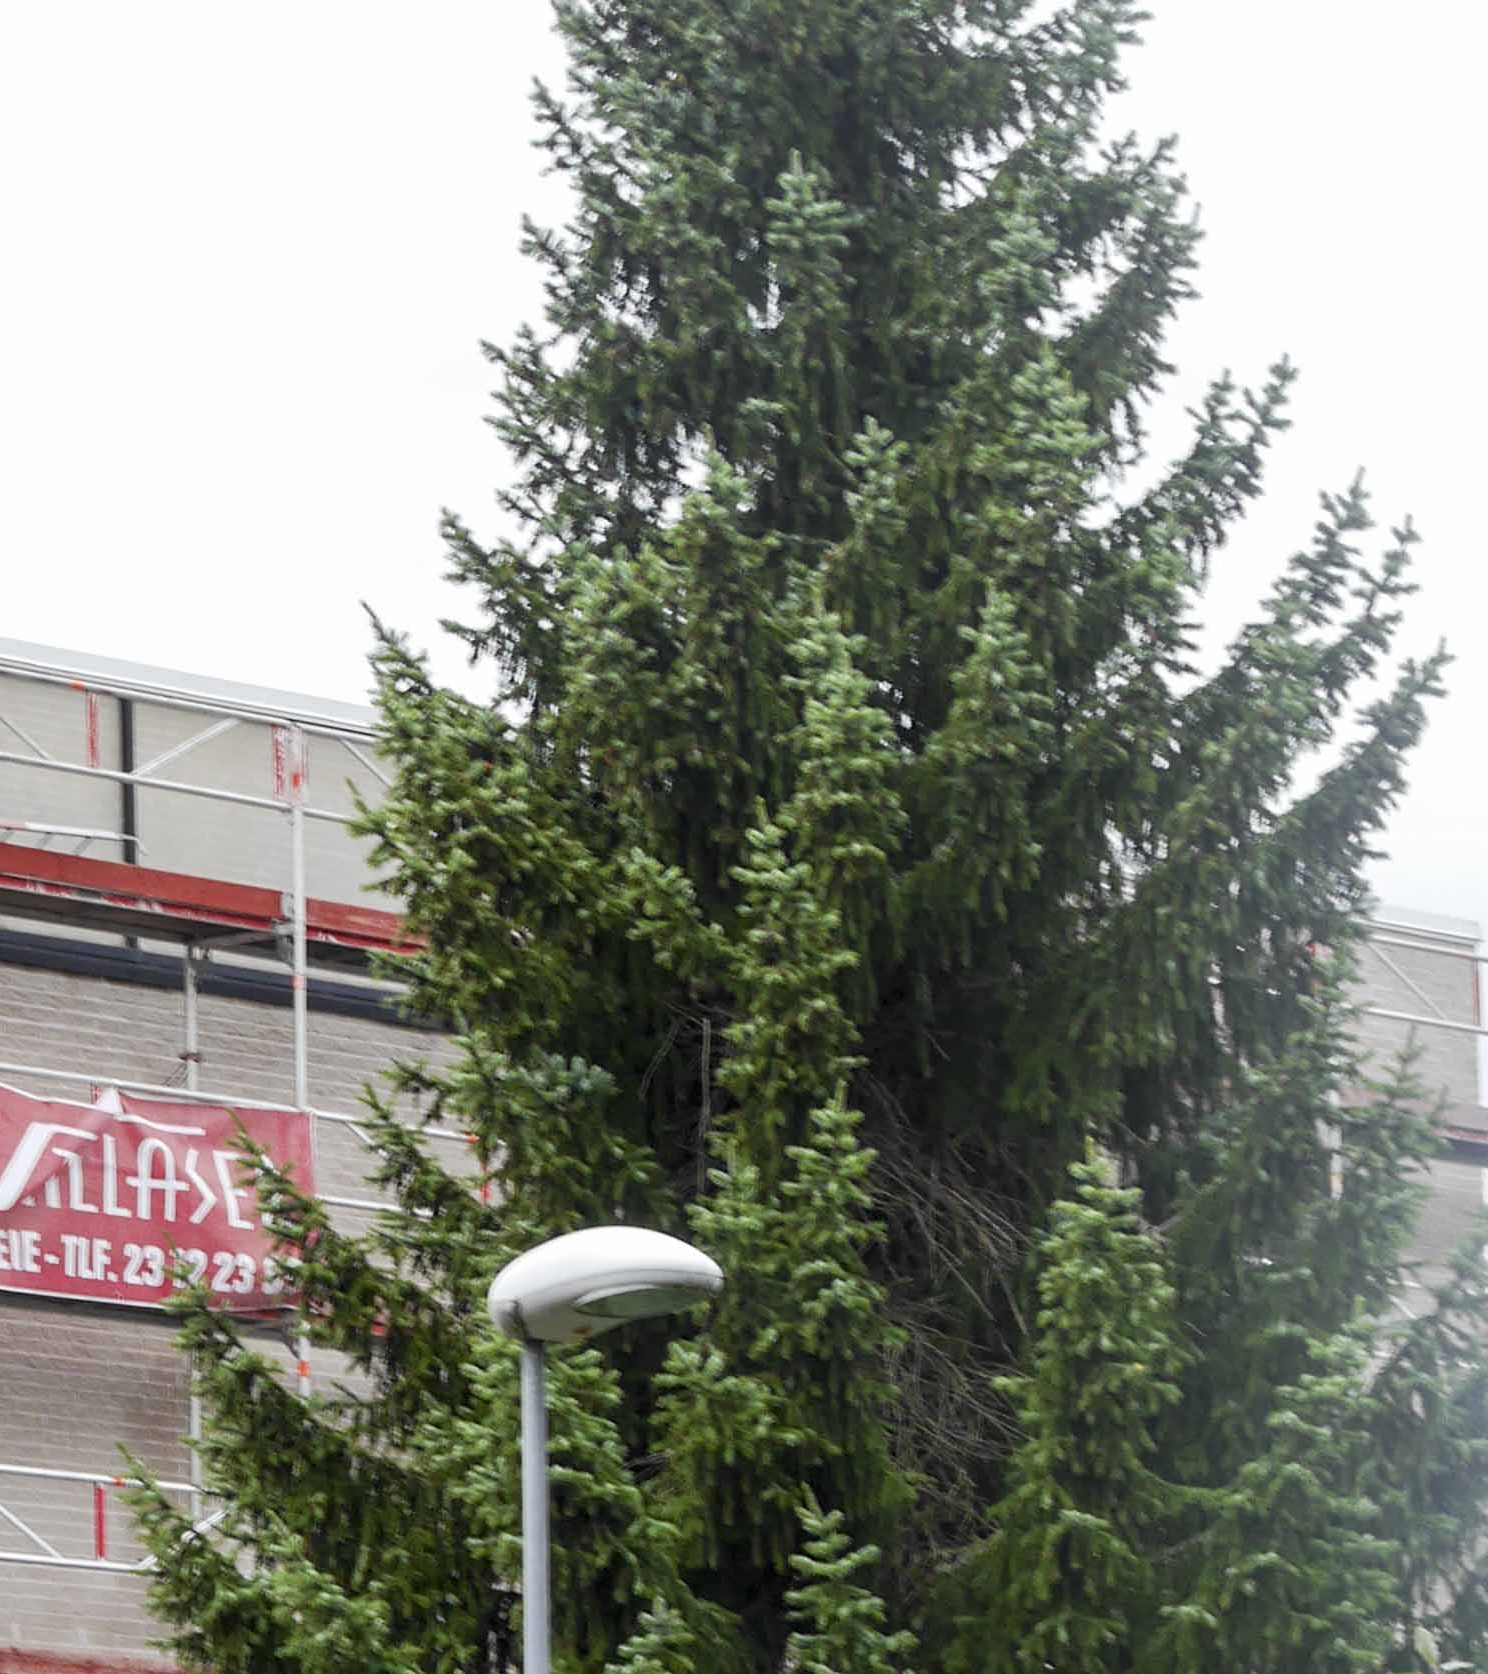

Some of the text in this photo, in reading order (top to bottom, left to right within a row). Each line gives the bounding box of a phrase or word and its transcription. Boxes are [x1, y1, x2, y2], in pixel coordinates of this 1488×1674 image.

[60, 1234, 119, 1283] TLF.
[123, 1243, 165, 1288] 23
[211, 1251, 257, 1294] 23
